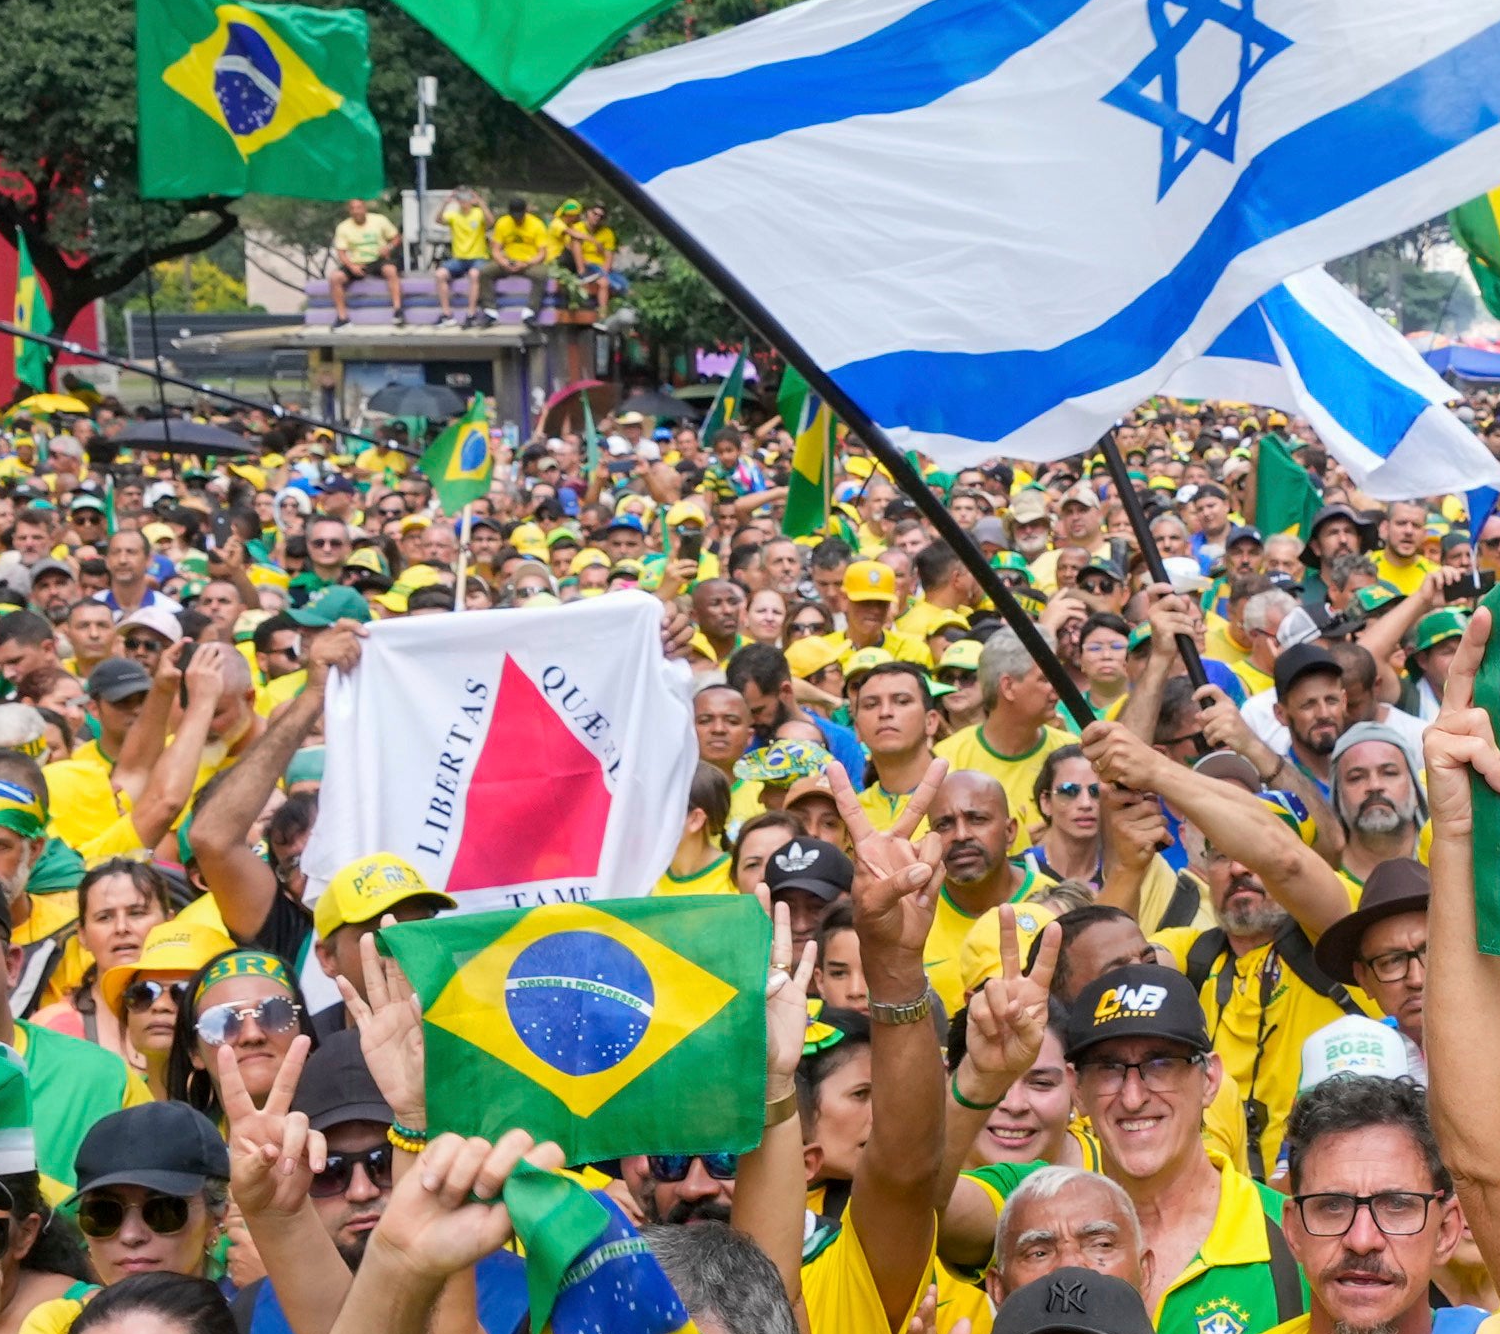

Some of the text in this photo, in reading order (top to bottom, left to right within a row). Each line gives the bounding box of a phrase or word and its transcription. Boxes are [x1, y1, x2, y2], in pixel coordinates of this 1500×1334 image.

[417, 678, 489, 858] LIBERTAS
[517, 977, 563, 988] ORDEM
[575, 980, 641, 1009] PROGRESSO
[1095, 984, 1168, 1018] CWB
[1325, 1040, 1384, 1059] 2022
